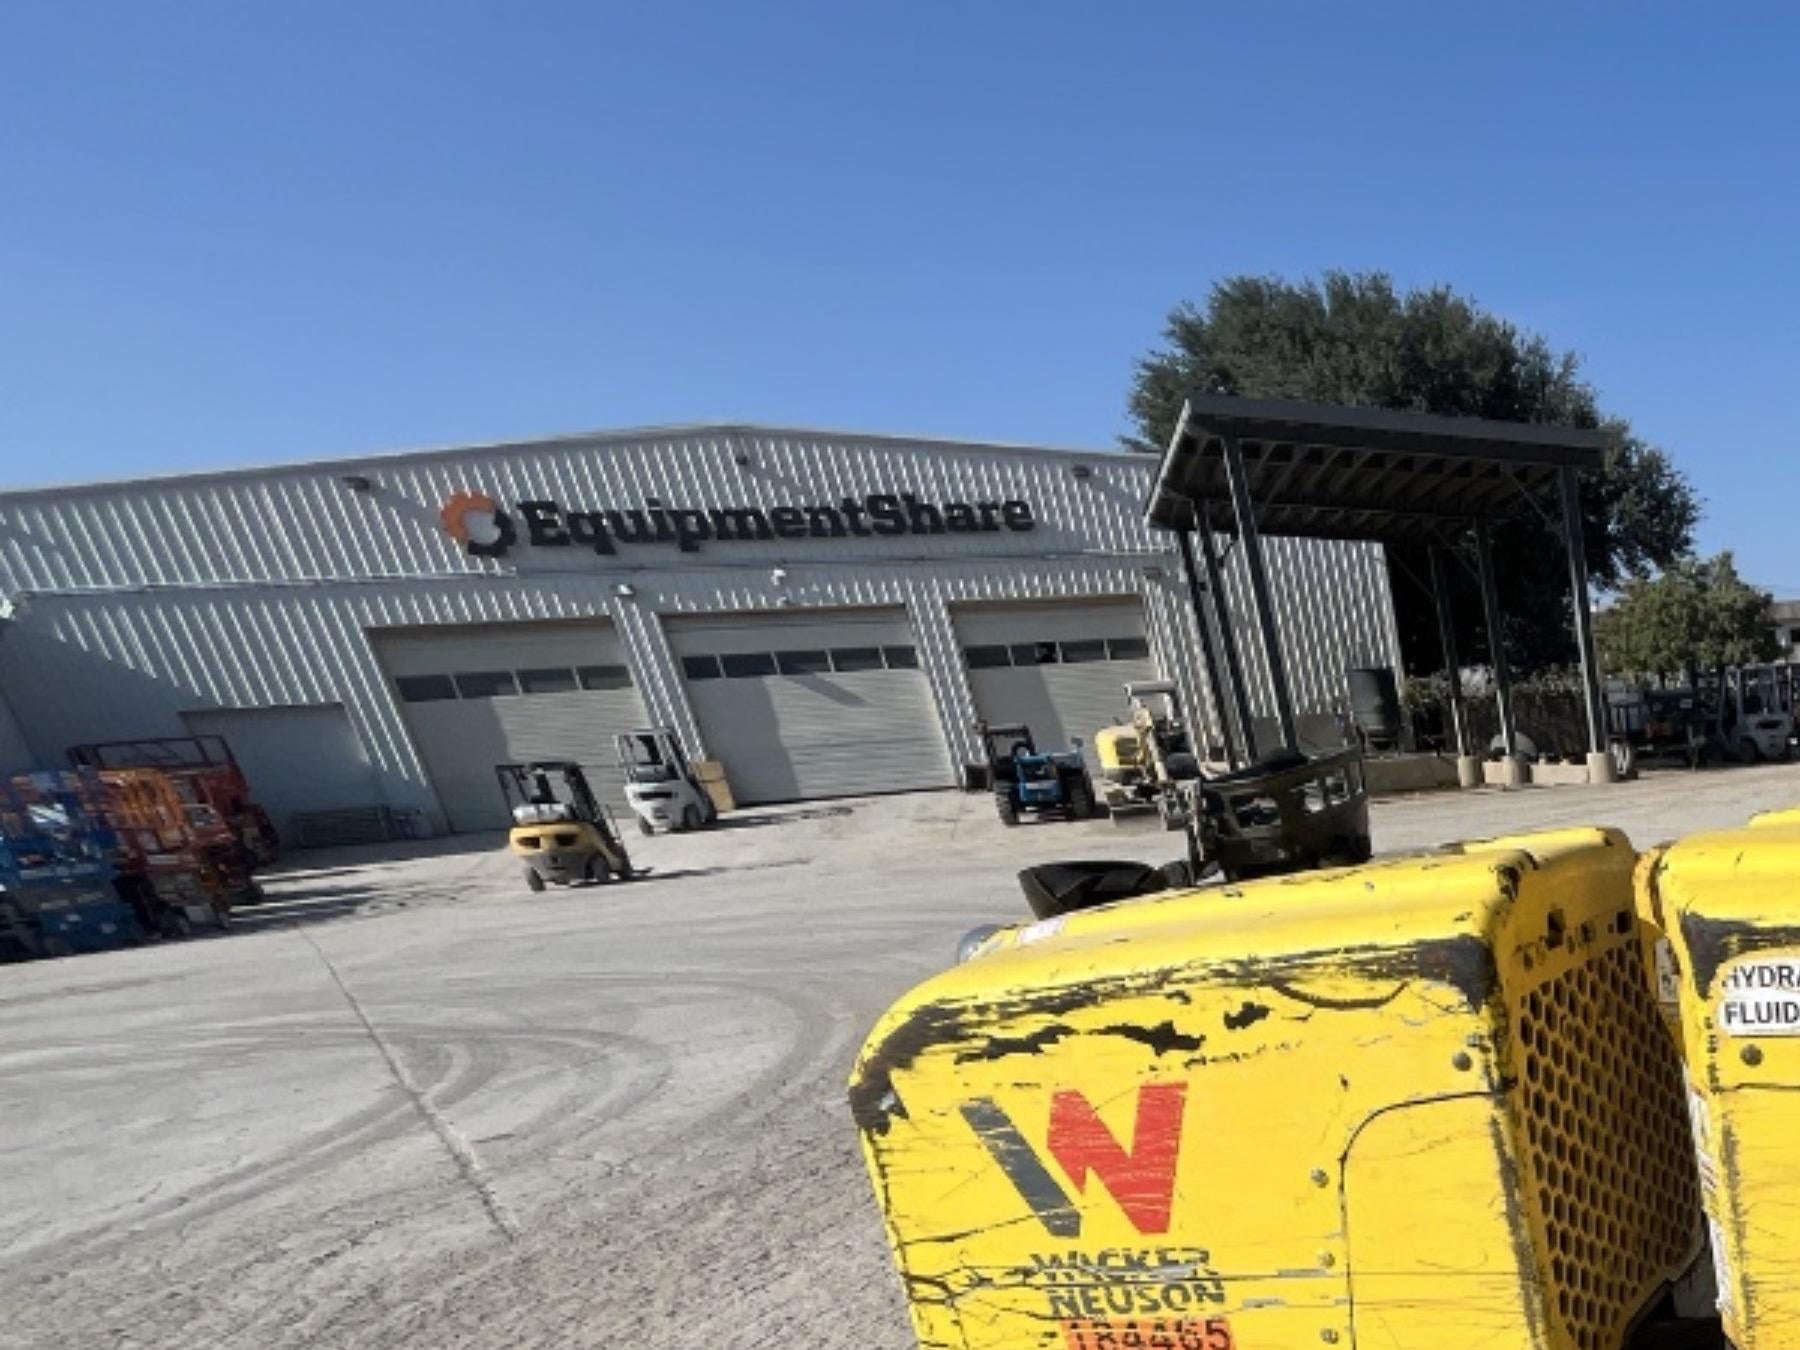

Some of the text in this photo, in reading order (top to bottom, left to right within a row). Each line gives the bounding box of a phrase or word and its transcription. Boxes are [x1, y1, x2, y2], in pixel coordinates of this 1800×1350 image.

[517, 491, 1034, 555] EquipmentShare
[1725, 1001, 1800, 1024] FLUID
[1047, 1279, 1225, 1318] NEUSON
